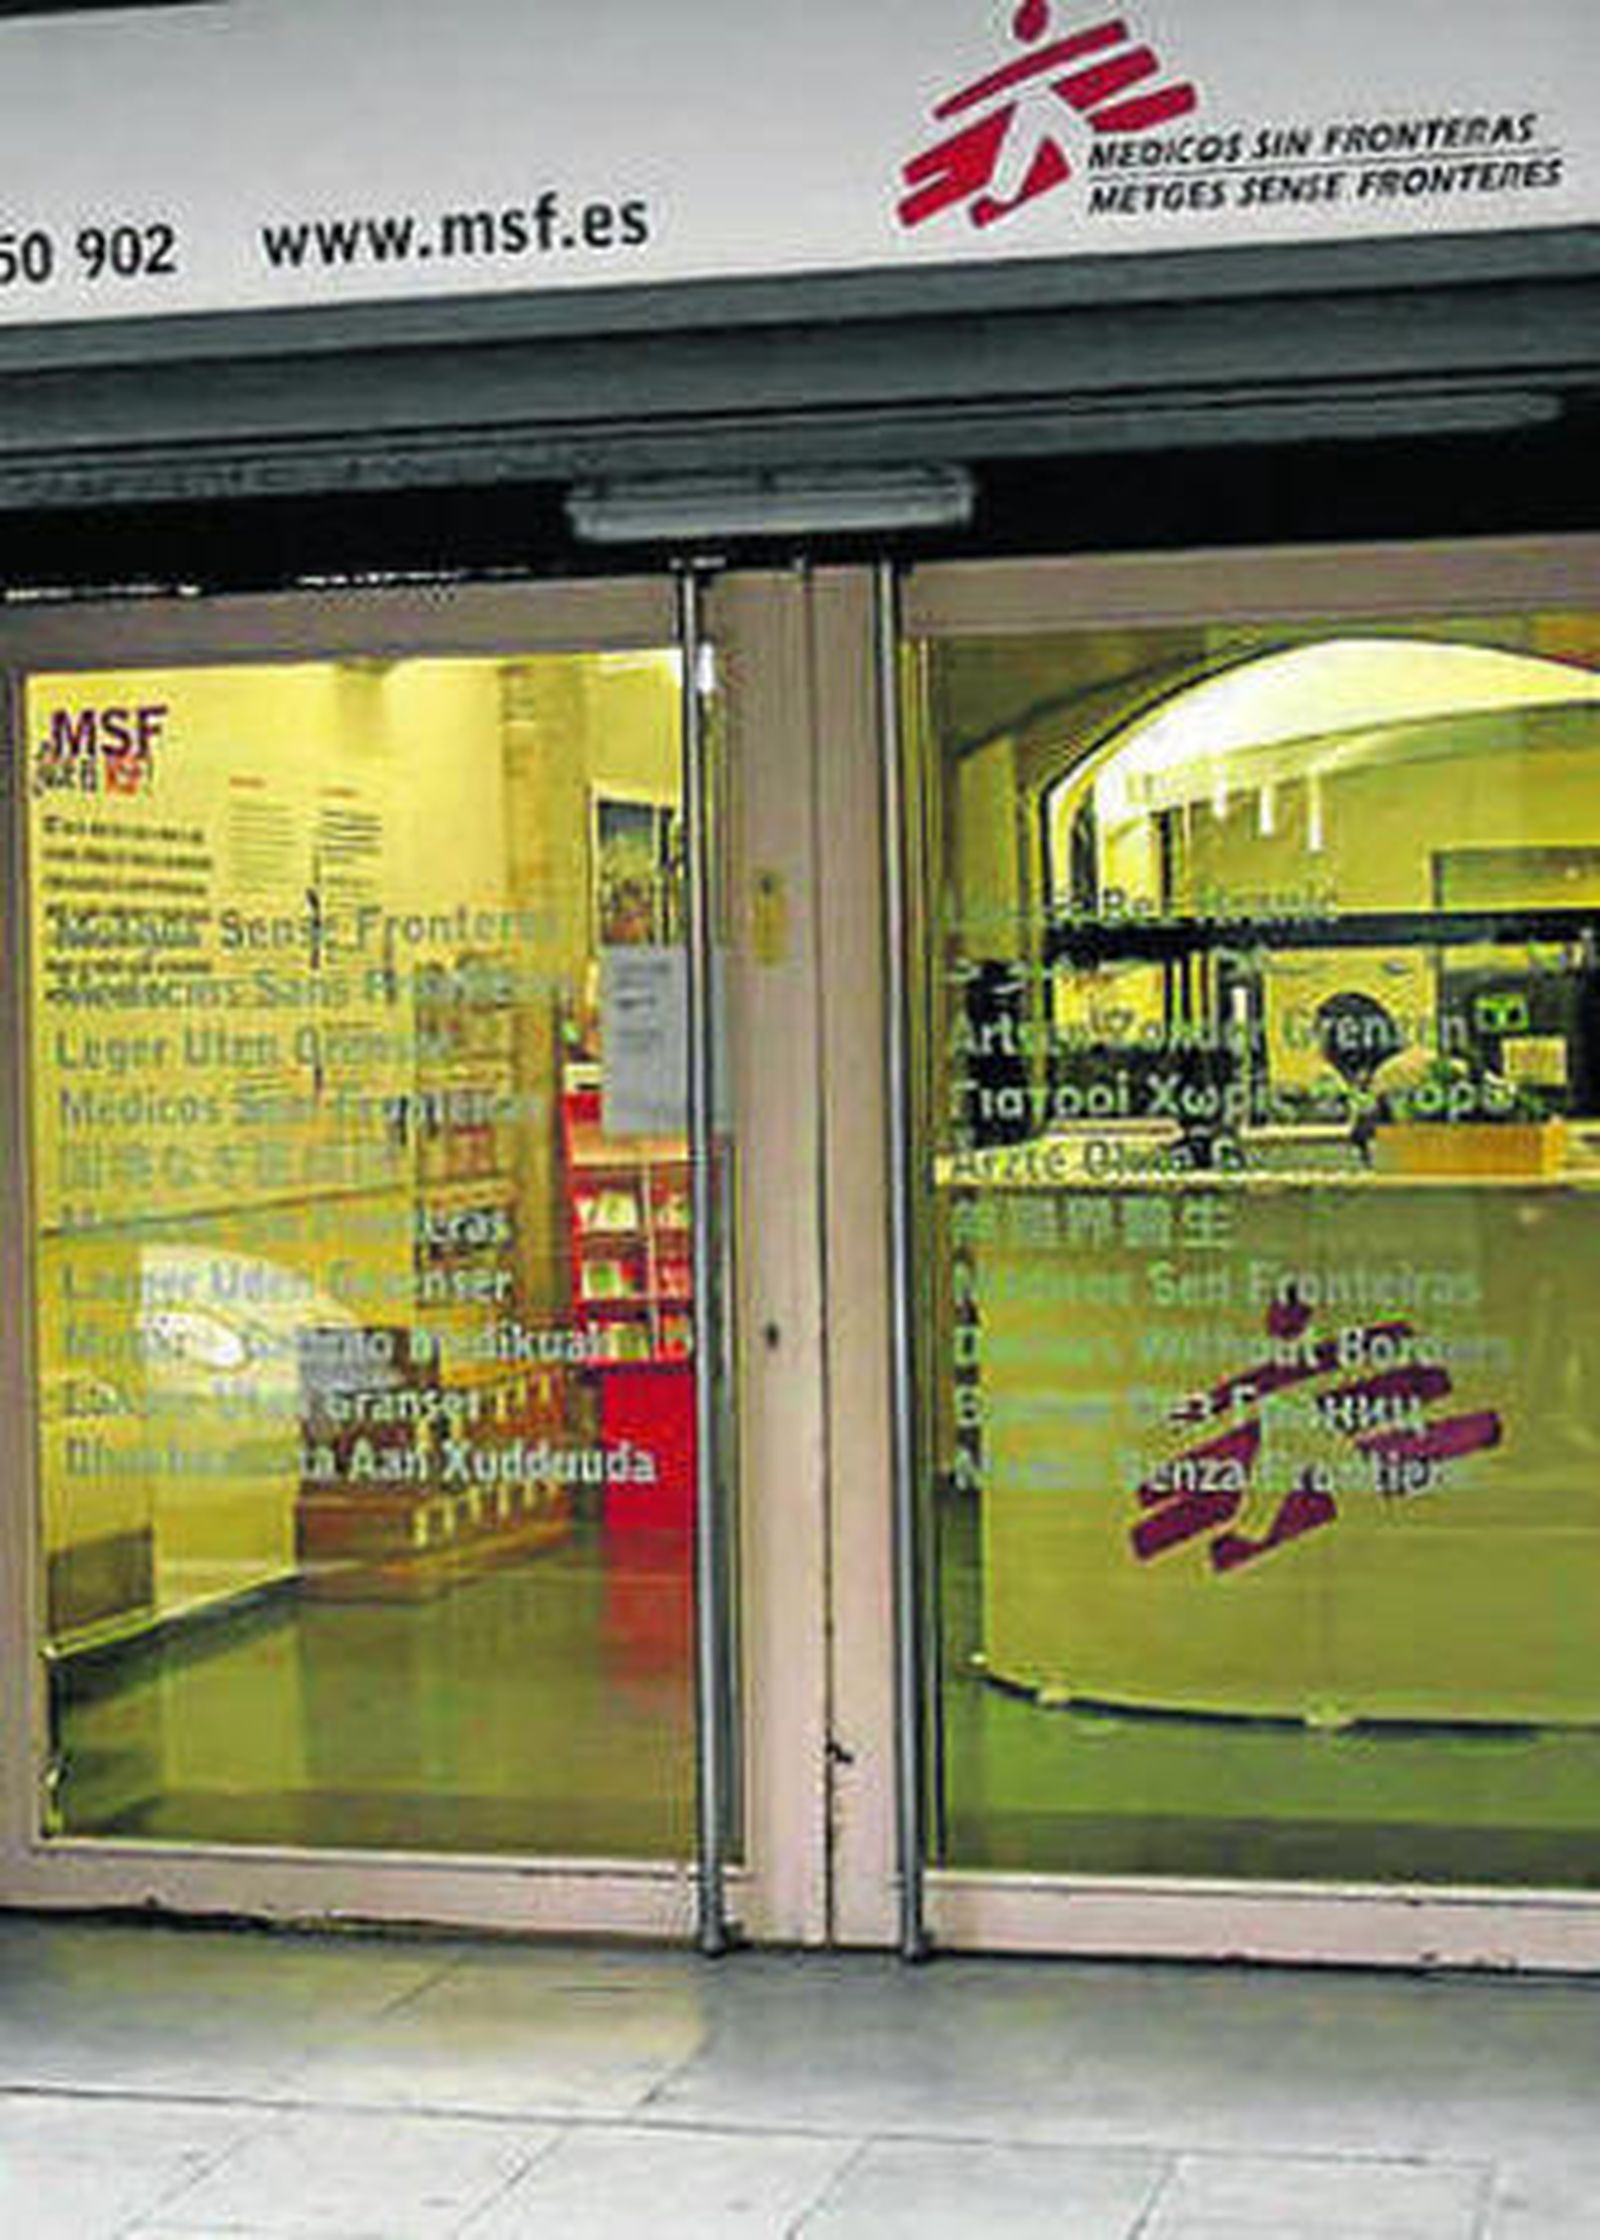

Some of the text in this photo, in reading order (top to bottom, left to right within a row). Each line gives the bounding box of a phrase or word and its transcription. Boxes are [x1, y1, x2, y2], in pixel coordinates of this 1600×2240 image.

[1252, 126, 1311, 157] SIN
[1324, 113, 1538, 153] FRONTERAS
[1087, 158, 1564, 214] METGES SENSE FRONTERES
[76, 224, 178, 281] 902
[261, 192, 650, 267] www.msf.es
